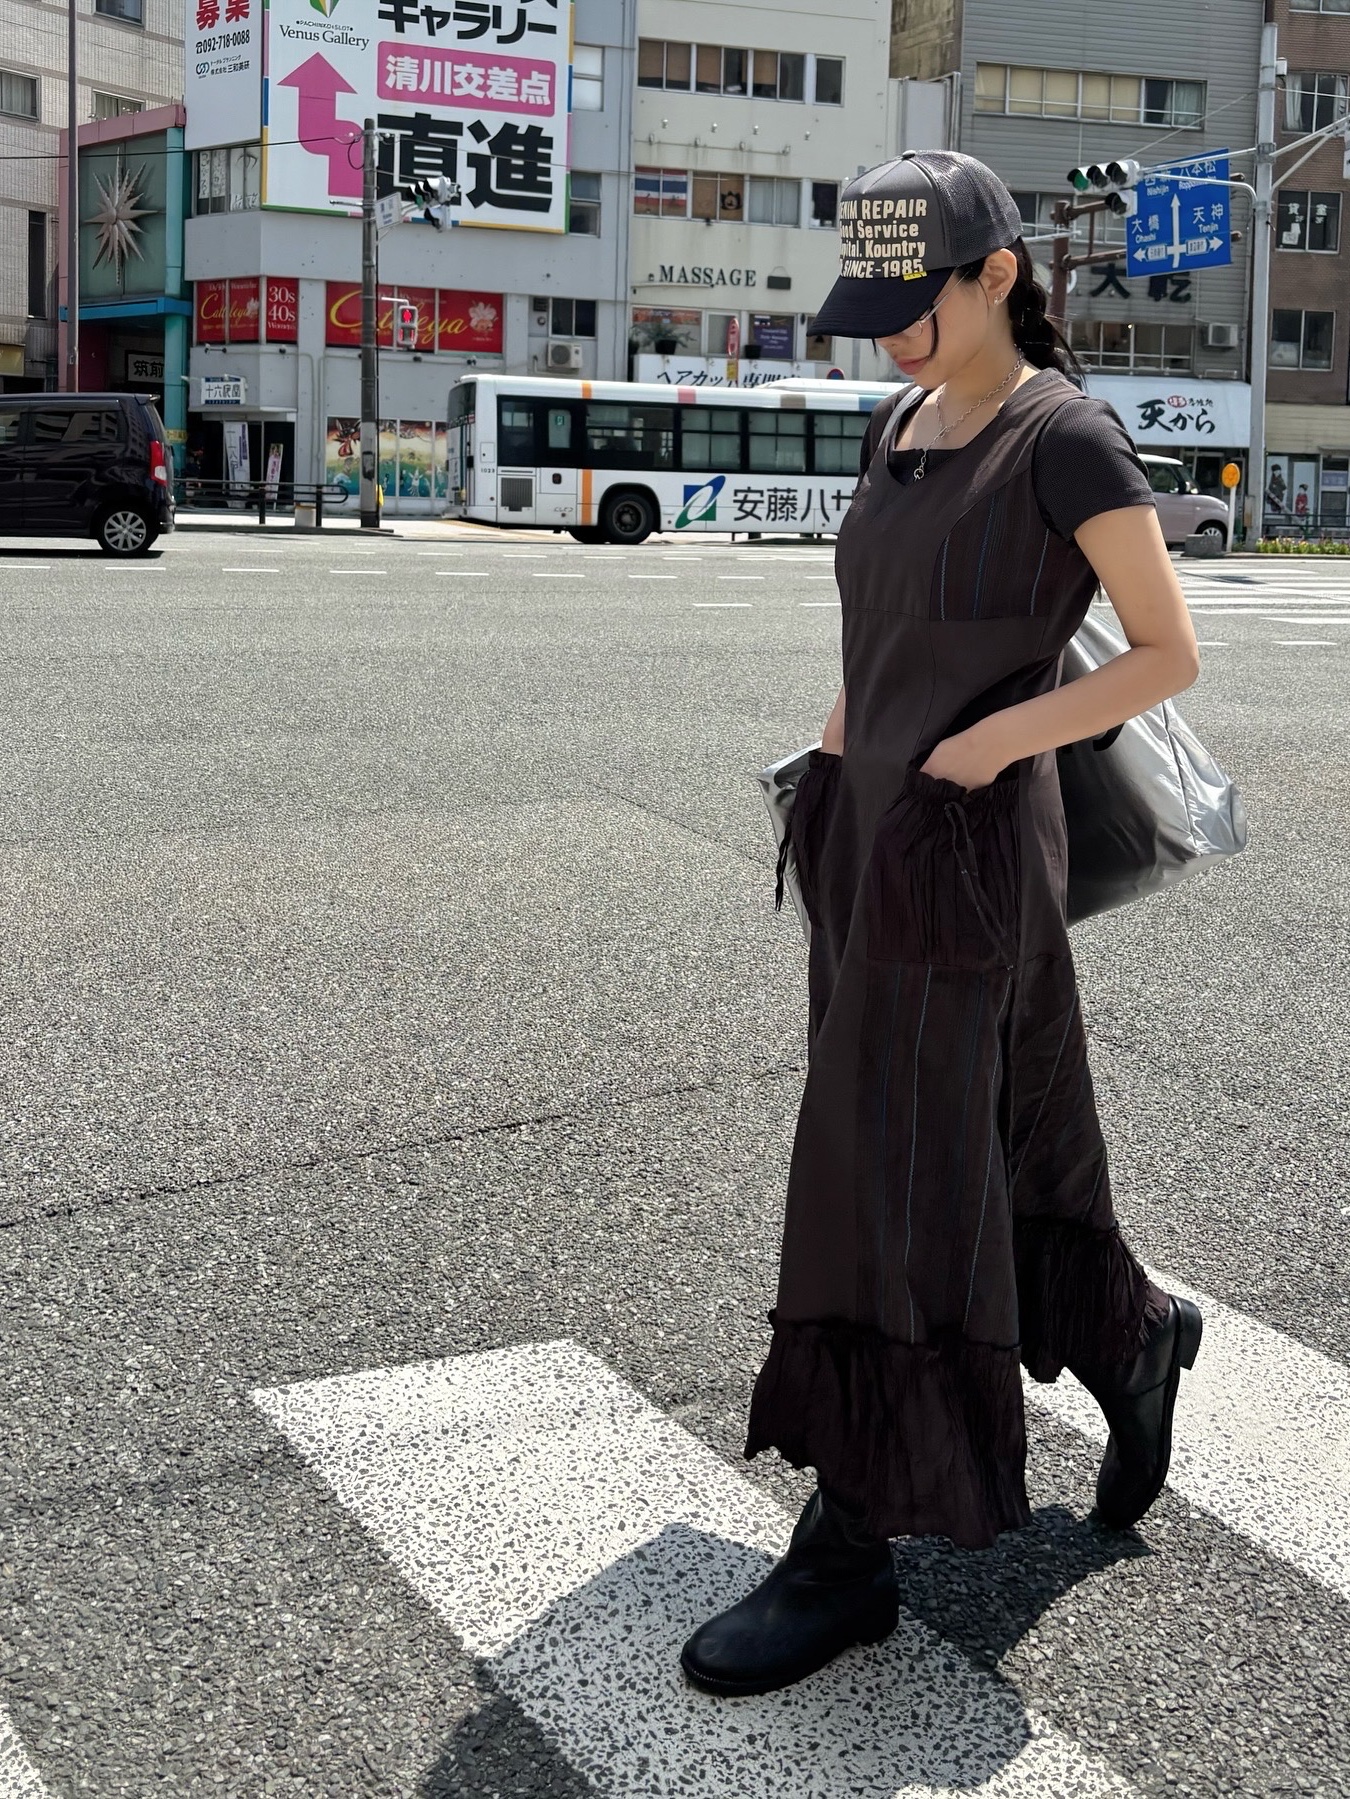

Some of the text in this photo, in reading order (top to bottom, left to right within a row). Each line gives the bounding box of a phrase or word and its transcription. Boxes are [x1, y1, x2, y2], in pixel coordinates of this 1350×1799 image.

[203, 29, 250, 52] 092-718-0088
[279, 24, 370, 51] Venus Gallery
[385, 54, 551, 106] 清川交差点
[377, 112, 554, 213] 直進
[862, 199, 927, 219] REPAIR
[1193, 203, 1224, 224] 天神
[857, 220, 919, 238] Service
[1131, 214, 1160, 234] 大橋
[865, 240, 926, 258] Kountry
[659, 264, 757, 287] MASSAGE
[268, 285, 296, 303] 30s
[268, 304, 296, 322] 40s
[1136, 399, 1215, 434] 天から
